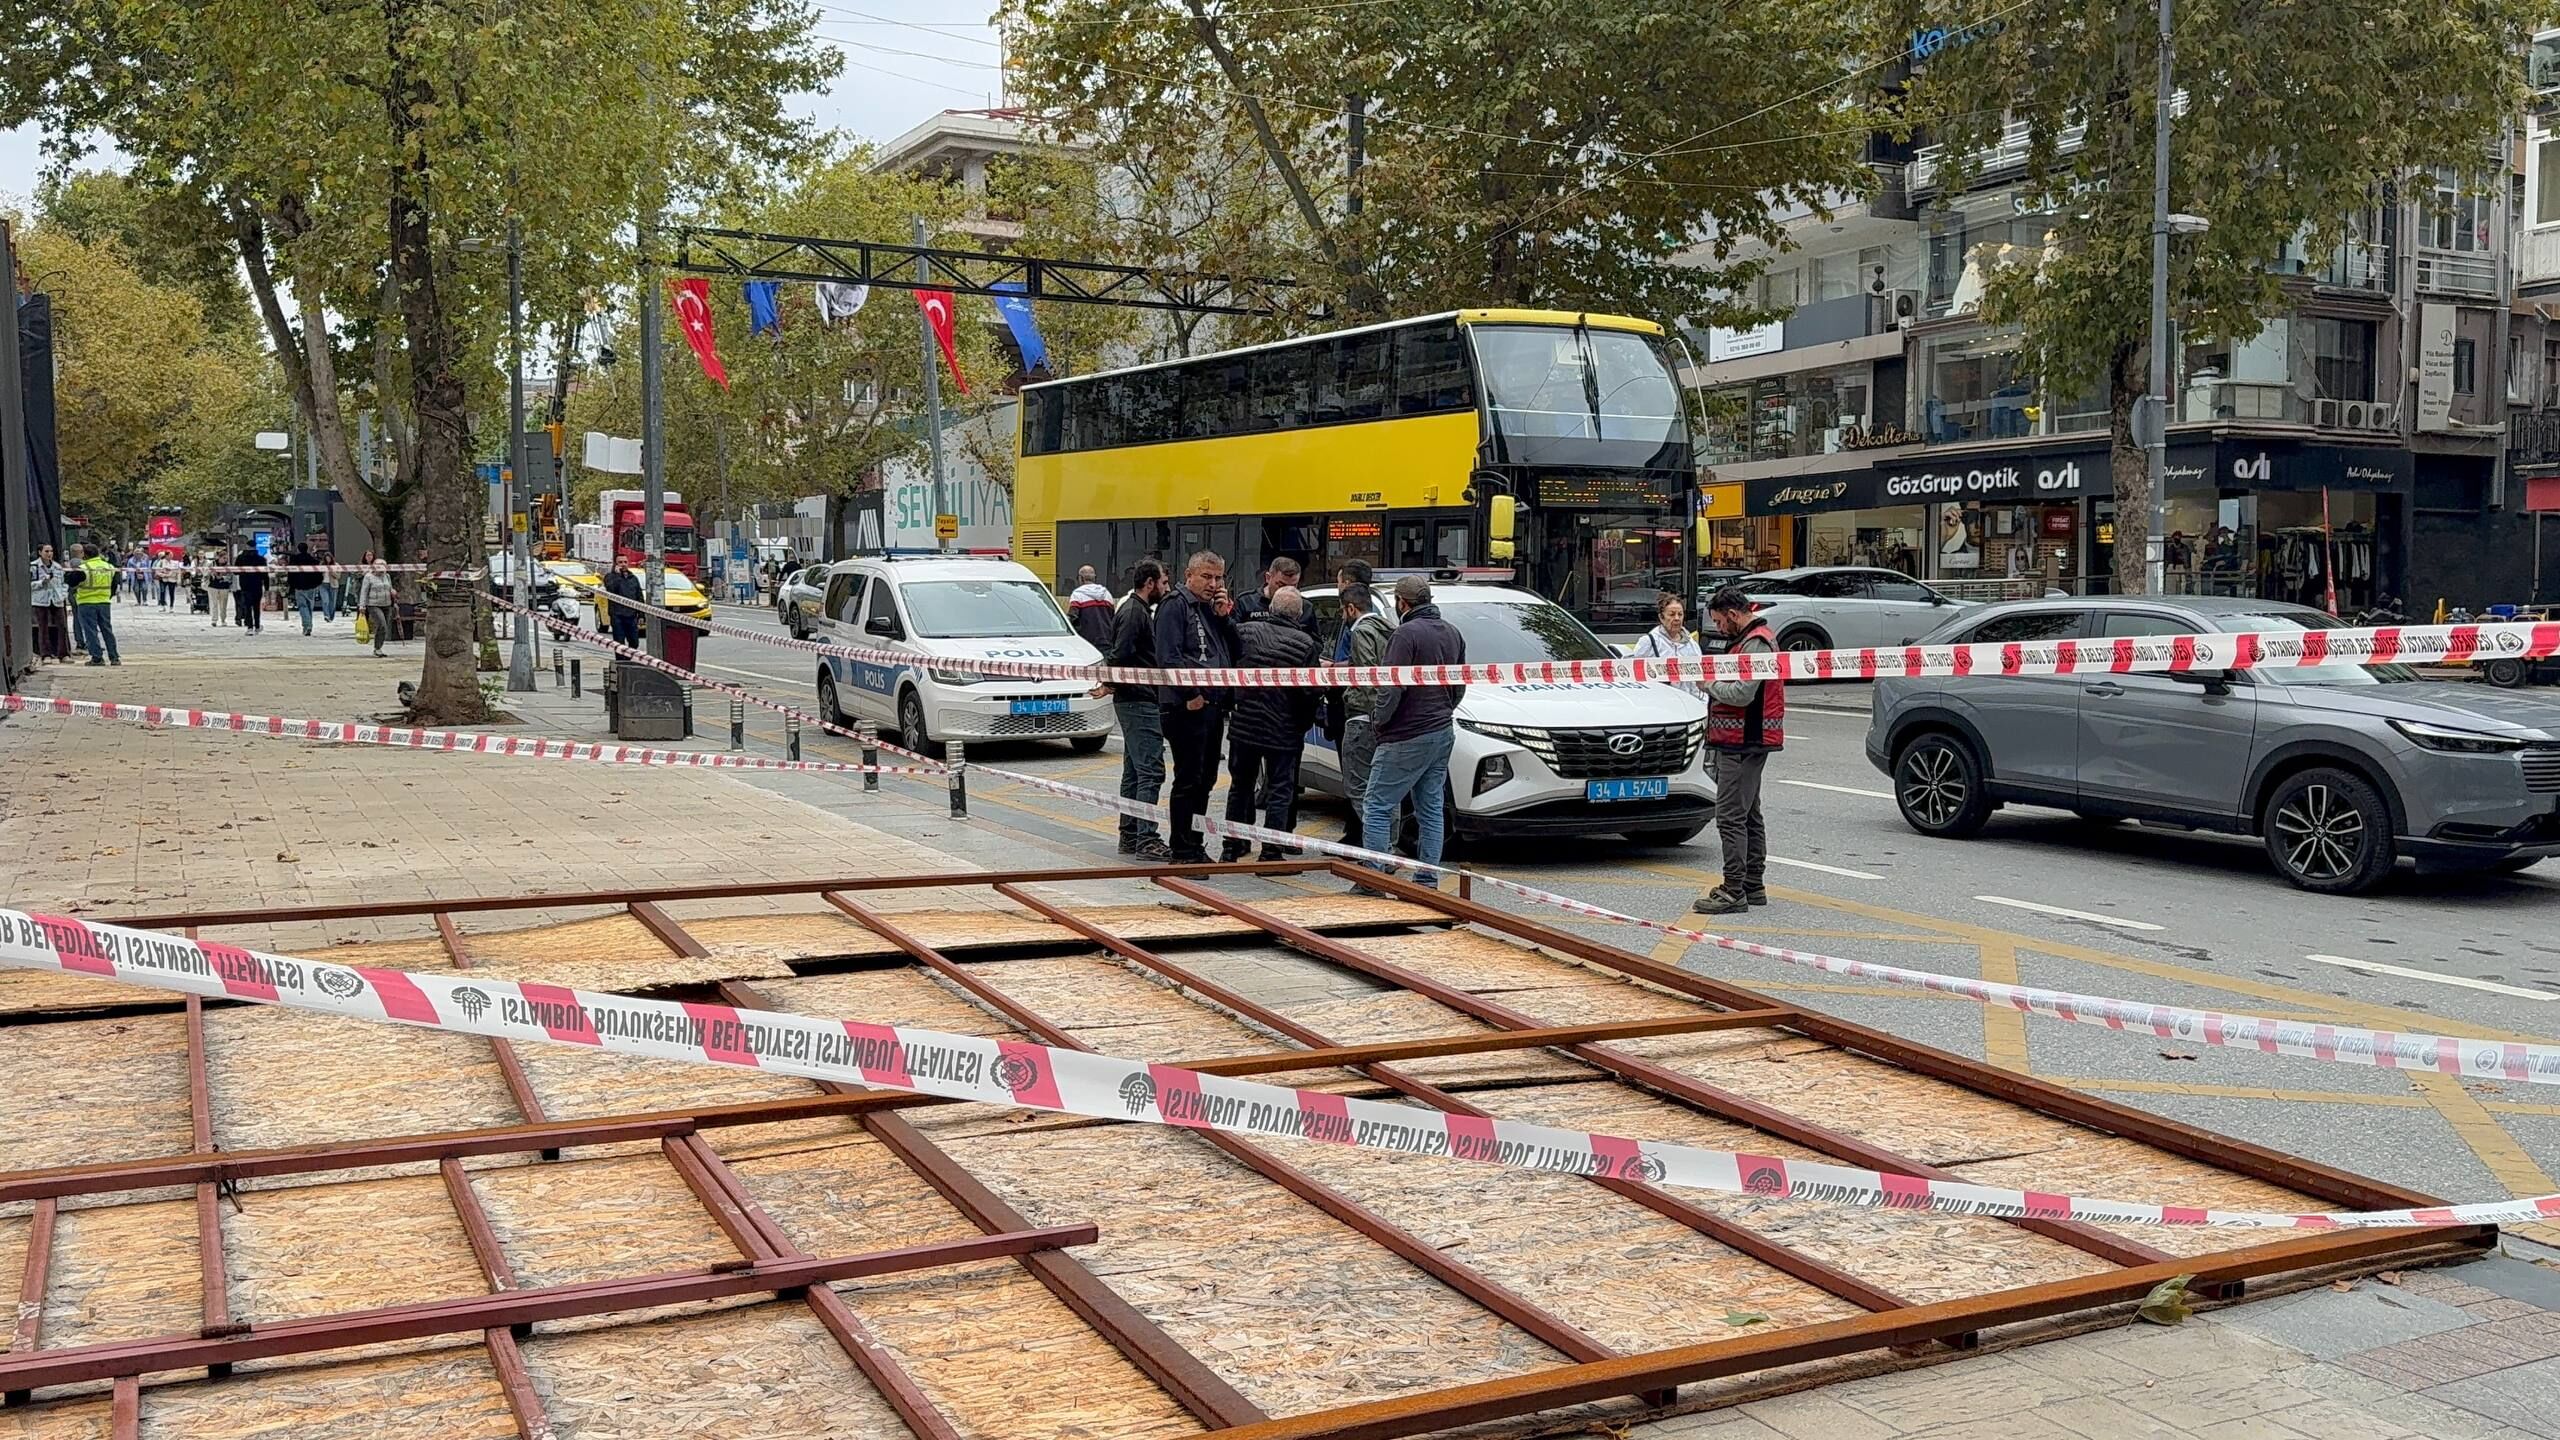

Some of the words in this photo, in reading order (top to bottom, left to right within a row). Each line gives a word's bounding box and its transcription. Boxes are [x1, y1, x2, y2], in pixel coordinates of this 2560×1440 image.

[1887, 473, 1963, 496] GözGrup
[1966, 467, 2020, 493] Optik
[1768, 484, 1831, 507] Angie
[984, 646, 1065, 658] POLİS
[864, 668, 885, 690] POLİS
[1017, 702, 1027, 712] 34
[1032, 701, 1037, 712] A
[1596, 783, 1610, 797] 34
[1618, 782, 1626, 797] A
[1632, 780, 1662, 796] 5740
